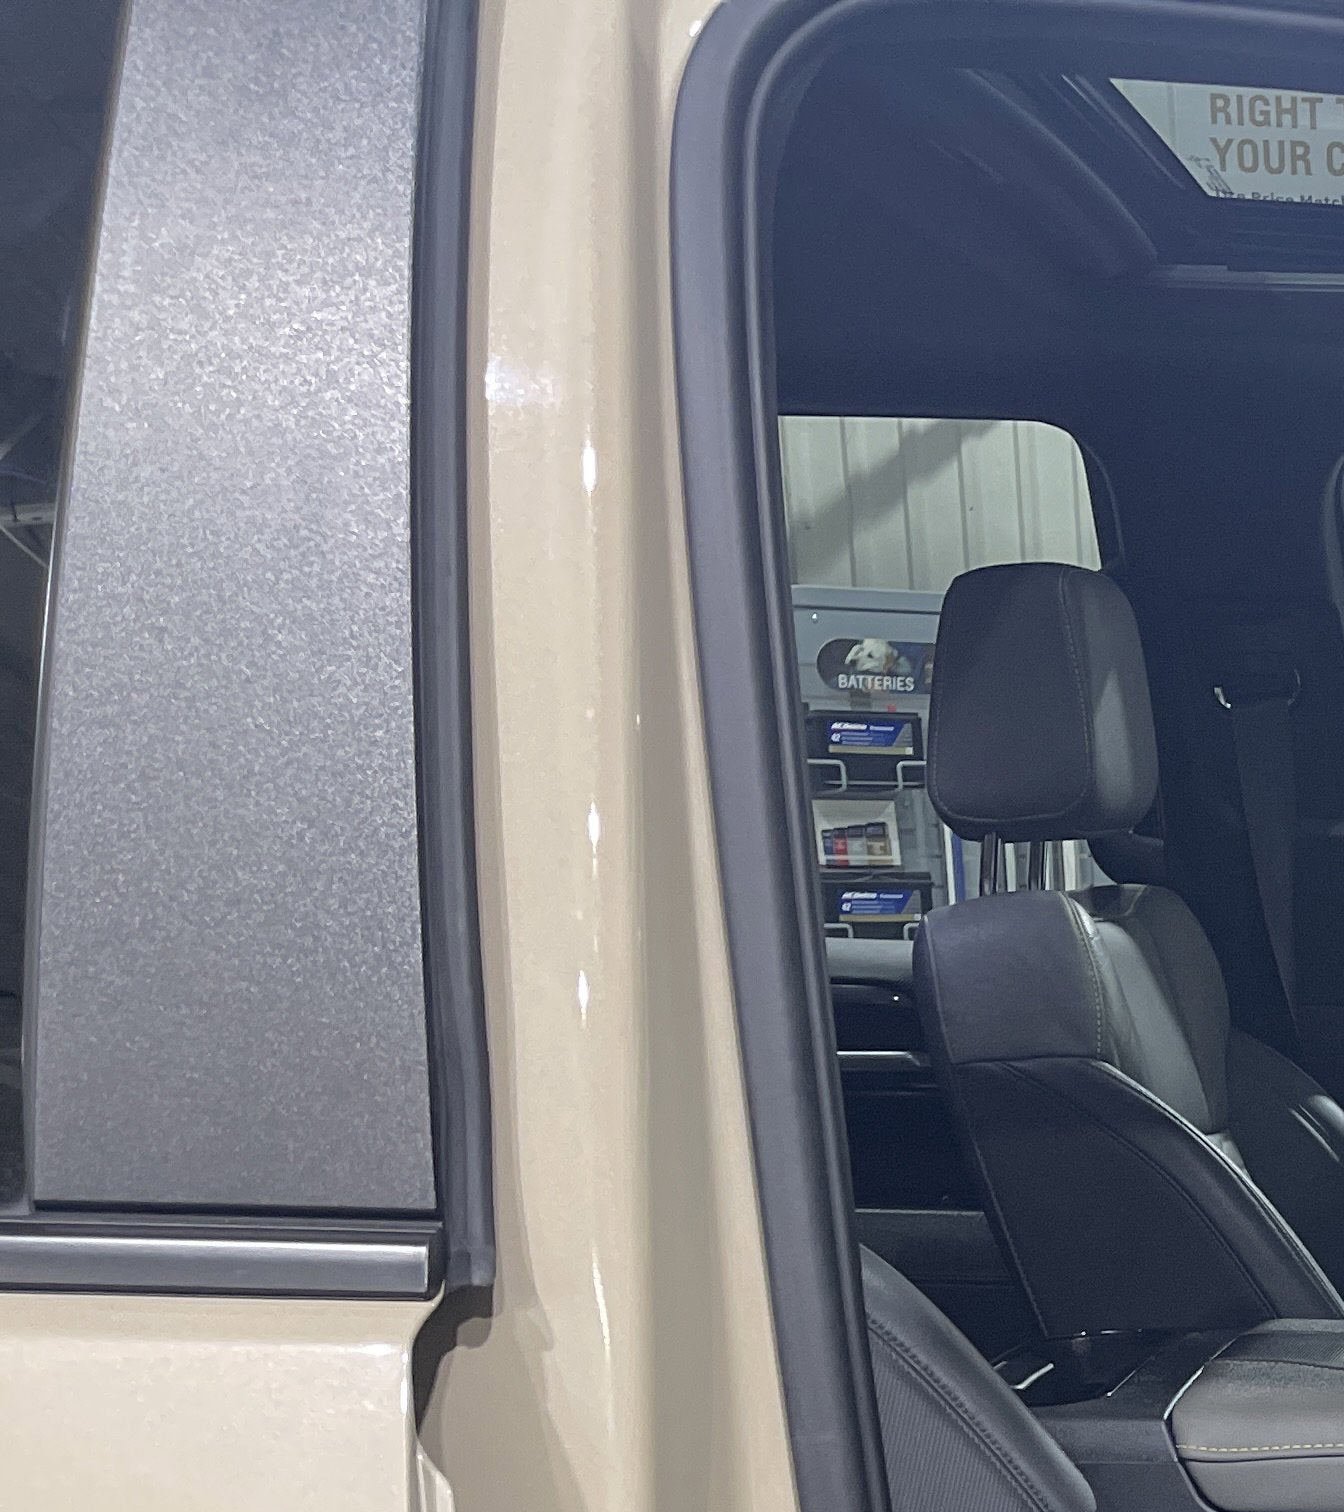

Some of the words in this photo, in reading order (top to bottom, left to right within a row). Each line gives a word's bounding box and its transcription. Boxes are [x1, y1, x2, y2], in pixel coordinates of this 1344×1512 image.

[1209, 92, 1324, 130] RIGHT
[1209, 137, 1313, 176] YOUR
[837, 673, 915, 692] BATTERIES
